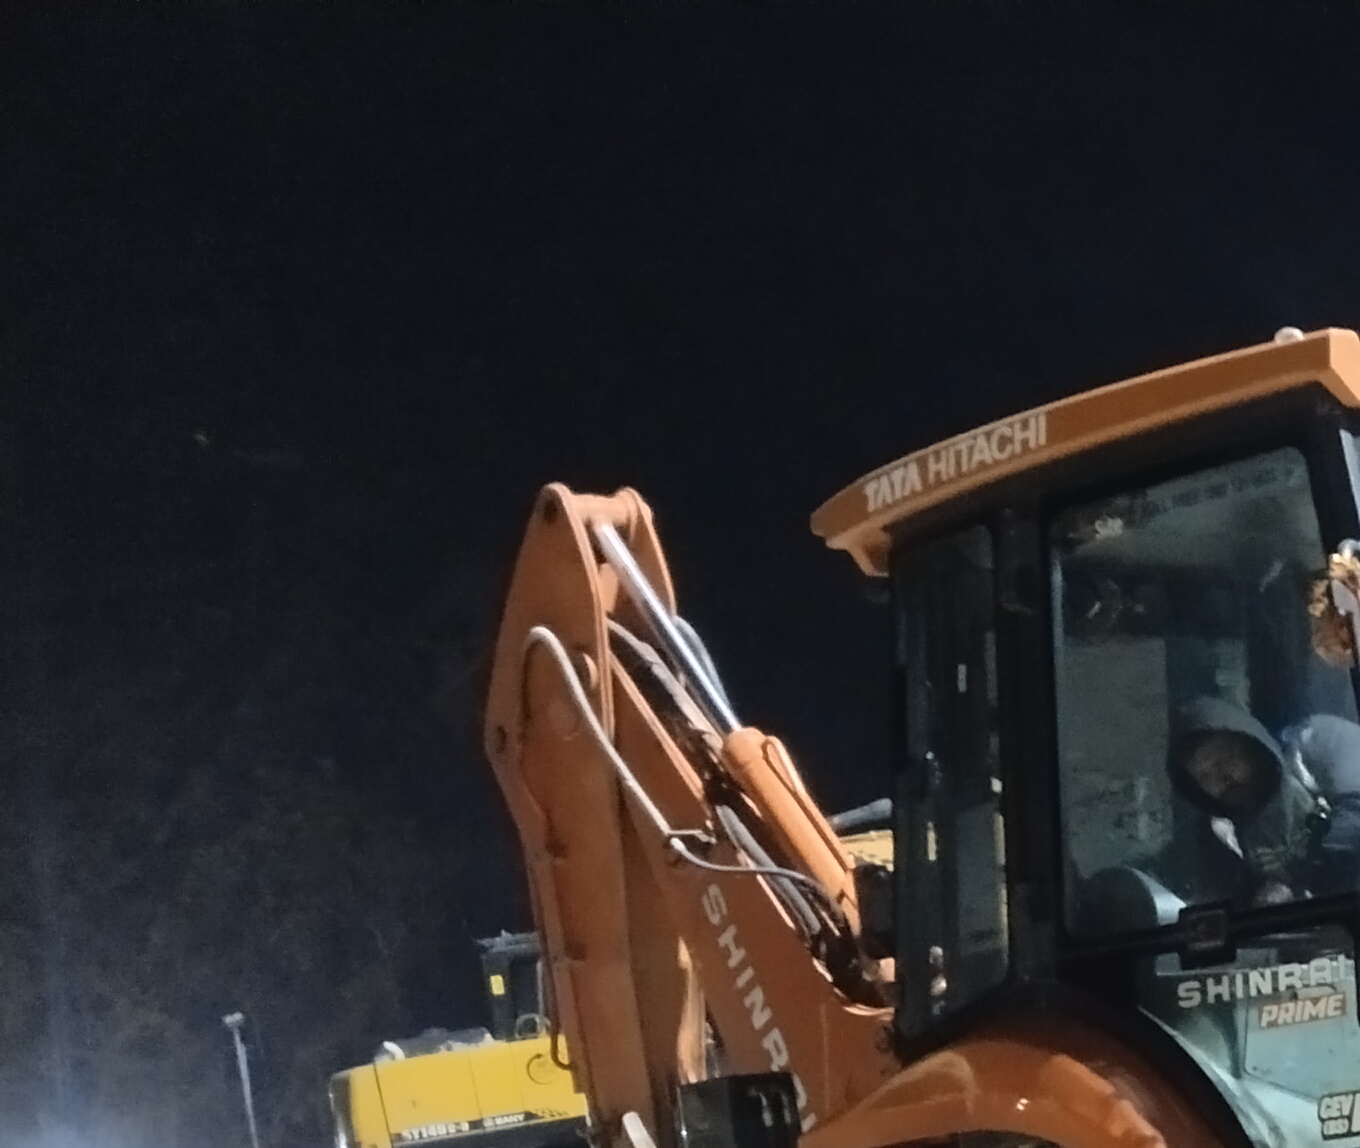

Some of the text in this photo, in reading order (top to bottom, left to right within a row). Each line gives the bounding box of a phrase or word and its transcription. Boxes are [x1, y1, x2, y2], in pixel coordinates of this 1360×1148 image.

[864, 413, 1047, 512] TATA HITACHI
[1177, 953, 1346, 1009] SHINRAI
[1260, 994, 1345, 1028] PRIME
